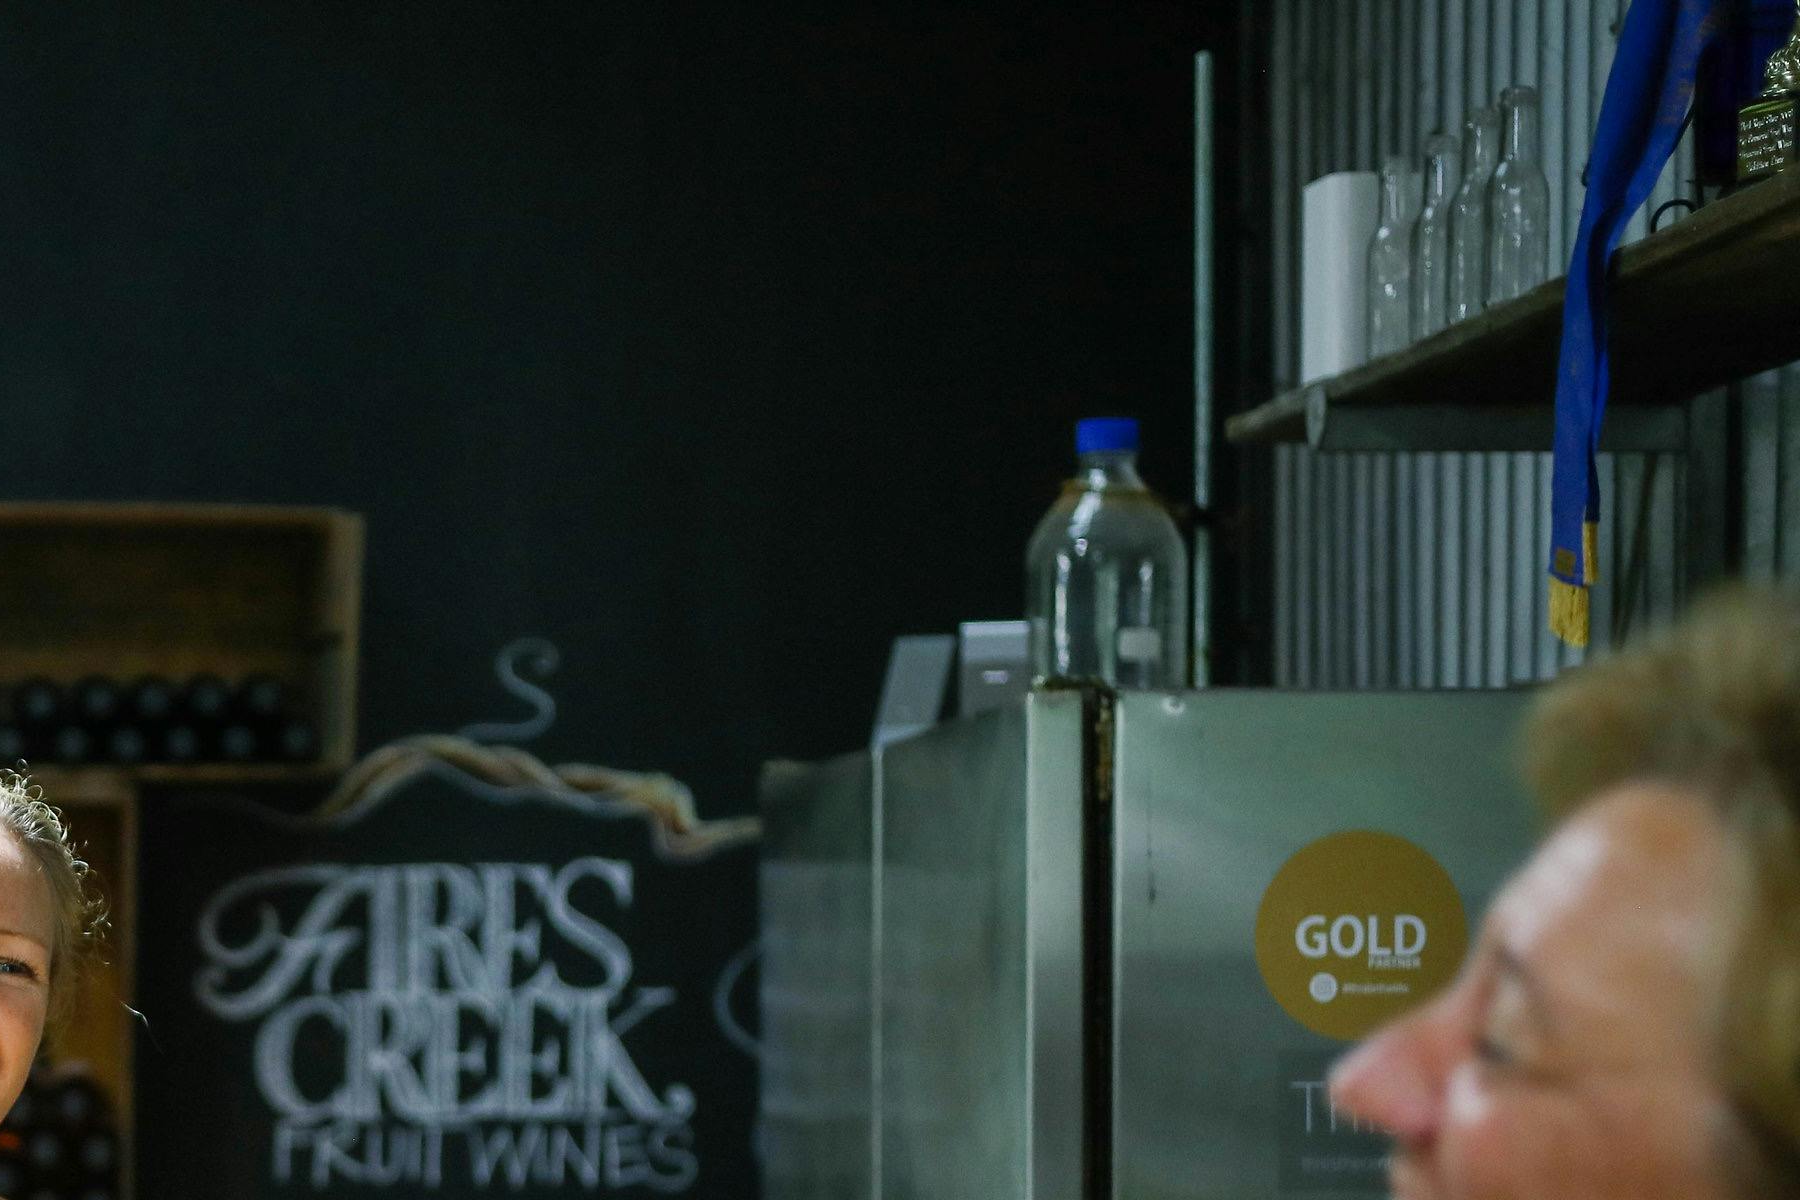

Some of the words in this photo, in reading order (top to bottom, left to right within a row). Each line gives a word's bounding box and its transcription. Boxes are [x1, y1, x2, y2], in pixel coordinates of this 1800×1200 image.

[1294, 914, 1427, 959] GOLD
[253, 983, 696, 1127] CREEK
[270, 1118, 444, 1190] FRUIT
[464, 1118, 700, 1193] WINES
